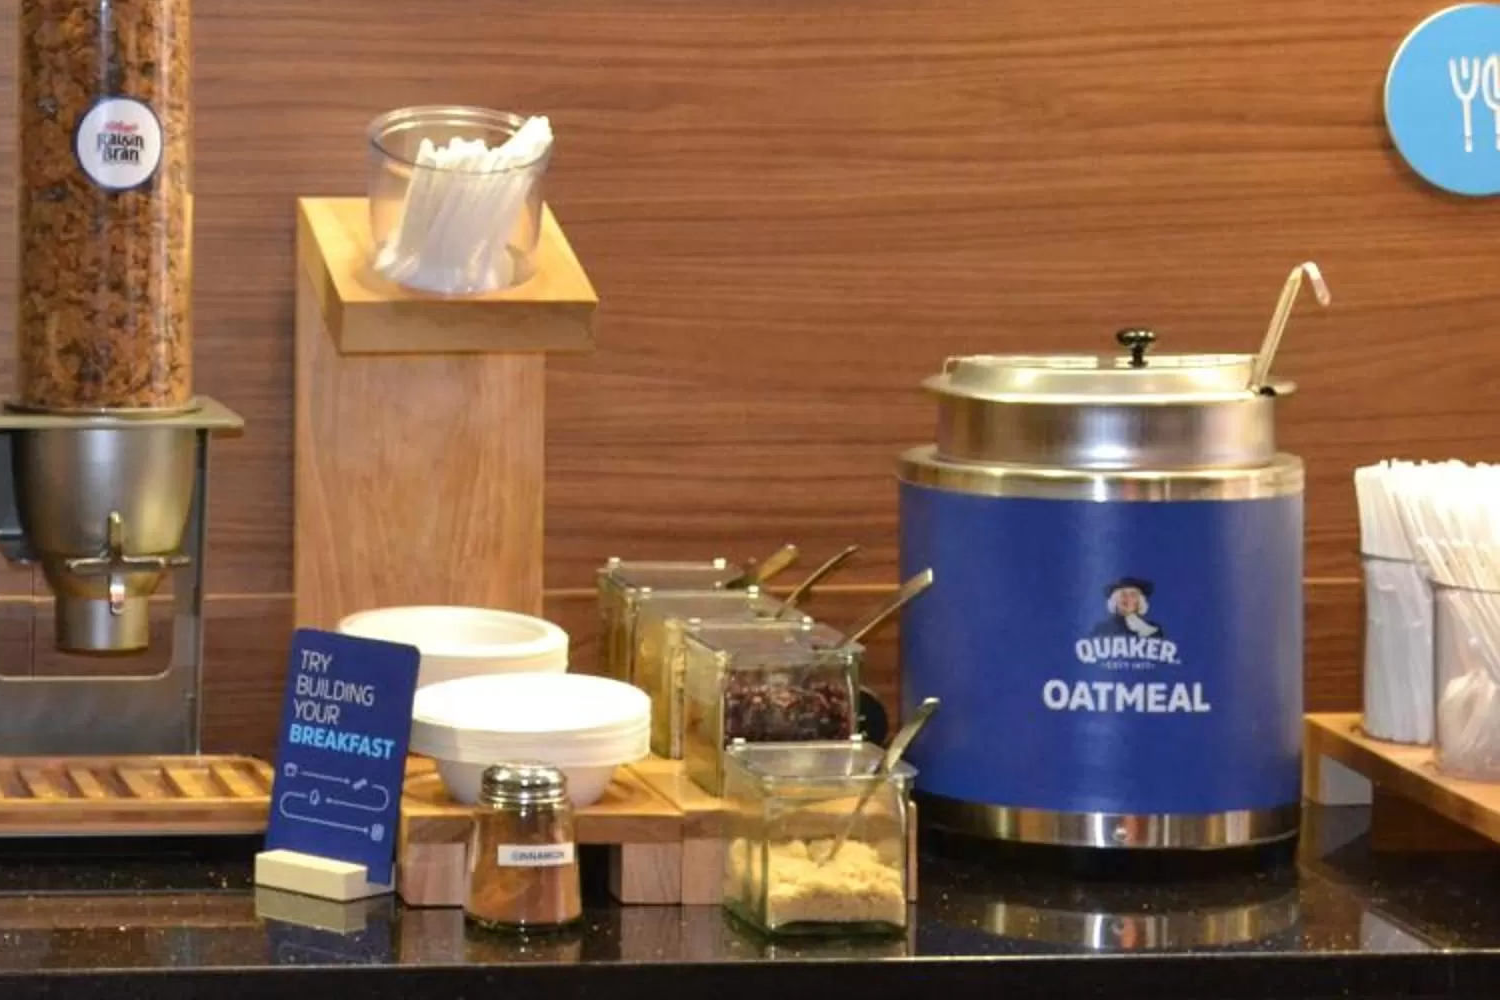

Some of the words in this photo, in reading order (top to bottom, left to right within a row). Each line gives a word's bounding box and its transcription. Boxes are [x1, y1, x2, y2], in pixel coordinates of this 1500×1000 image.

[300, 649, 333, 673] TRY
[1075, 634, 1178, 664] QUAKER
[295, 674, 376, 707] BUILDING
[1042, 678, 1212, 713] OATMEAL
[292, 697, 341, 725] YOUR
[288, 722, 396, 760] BREAKFAST
